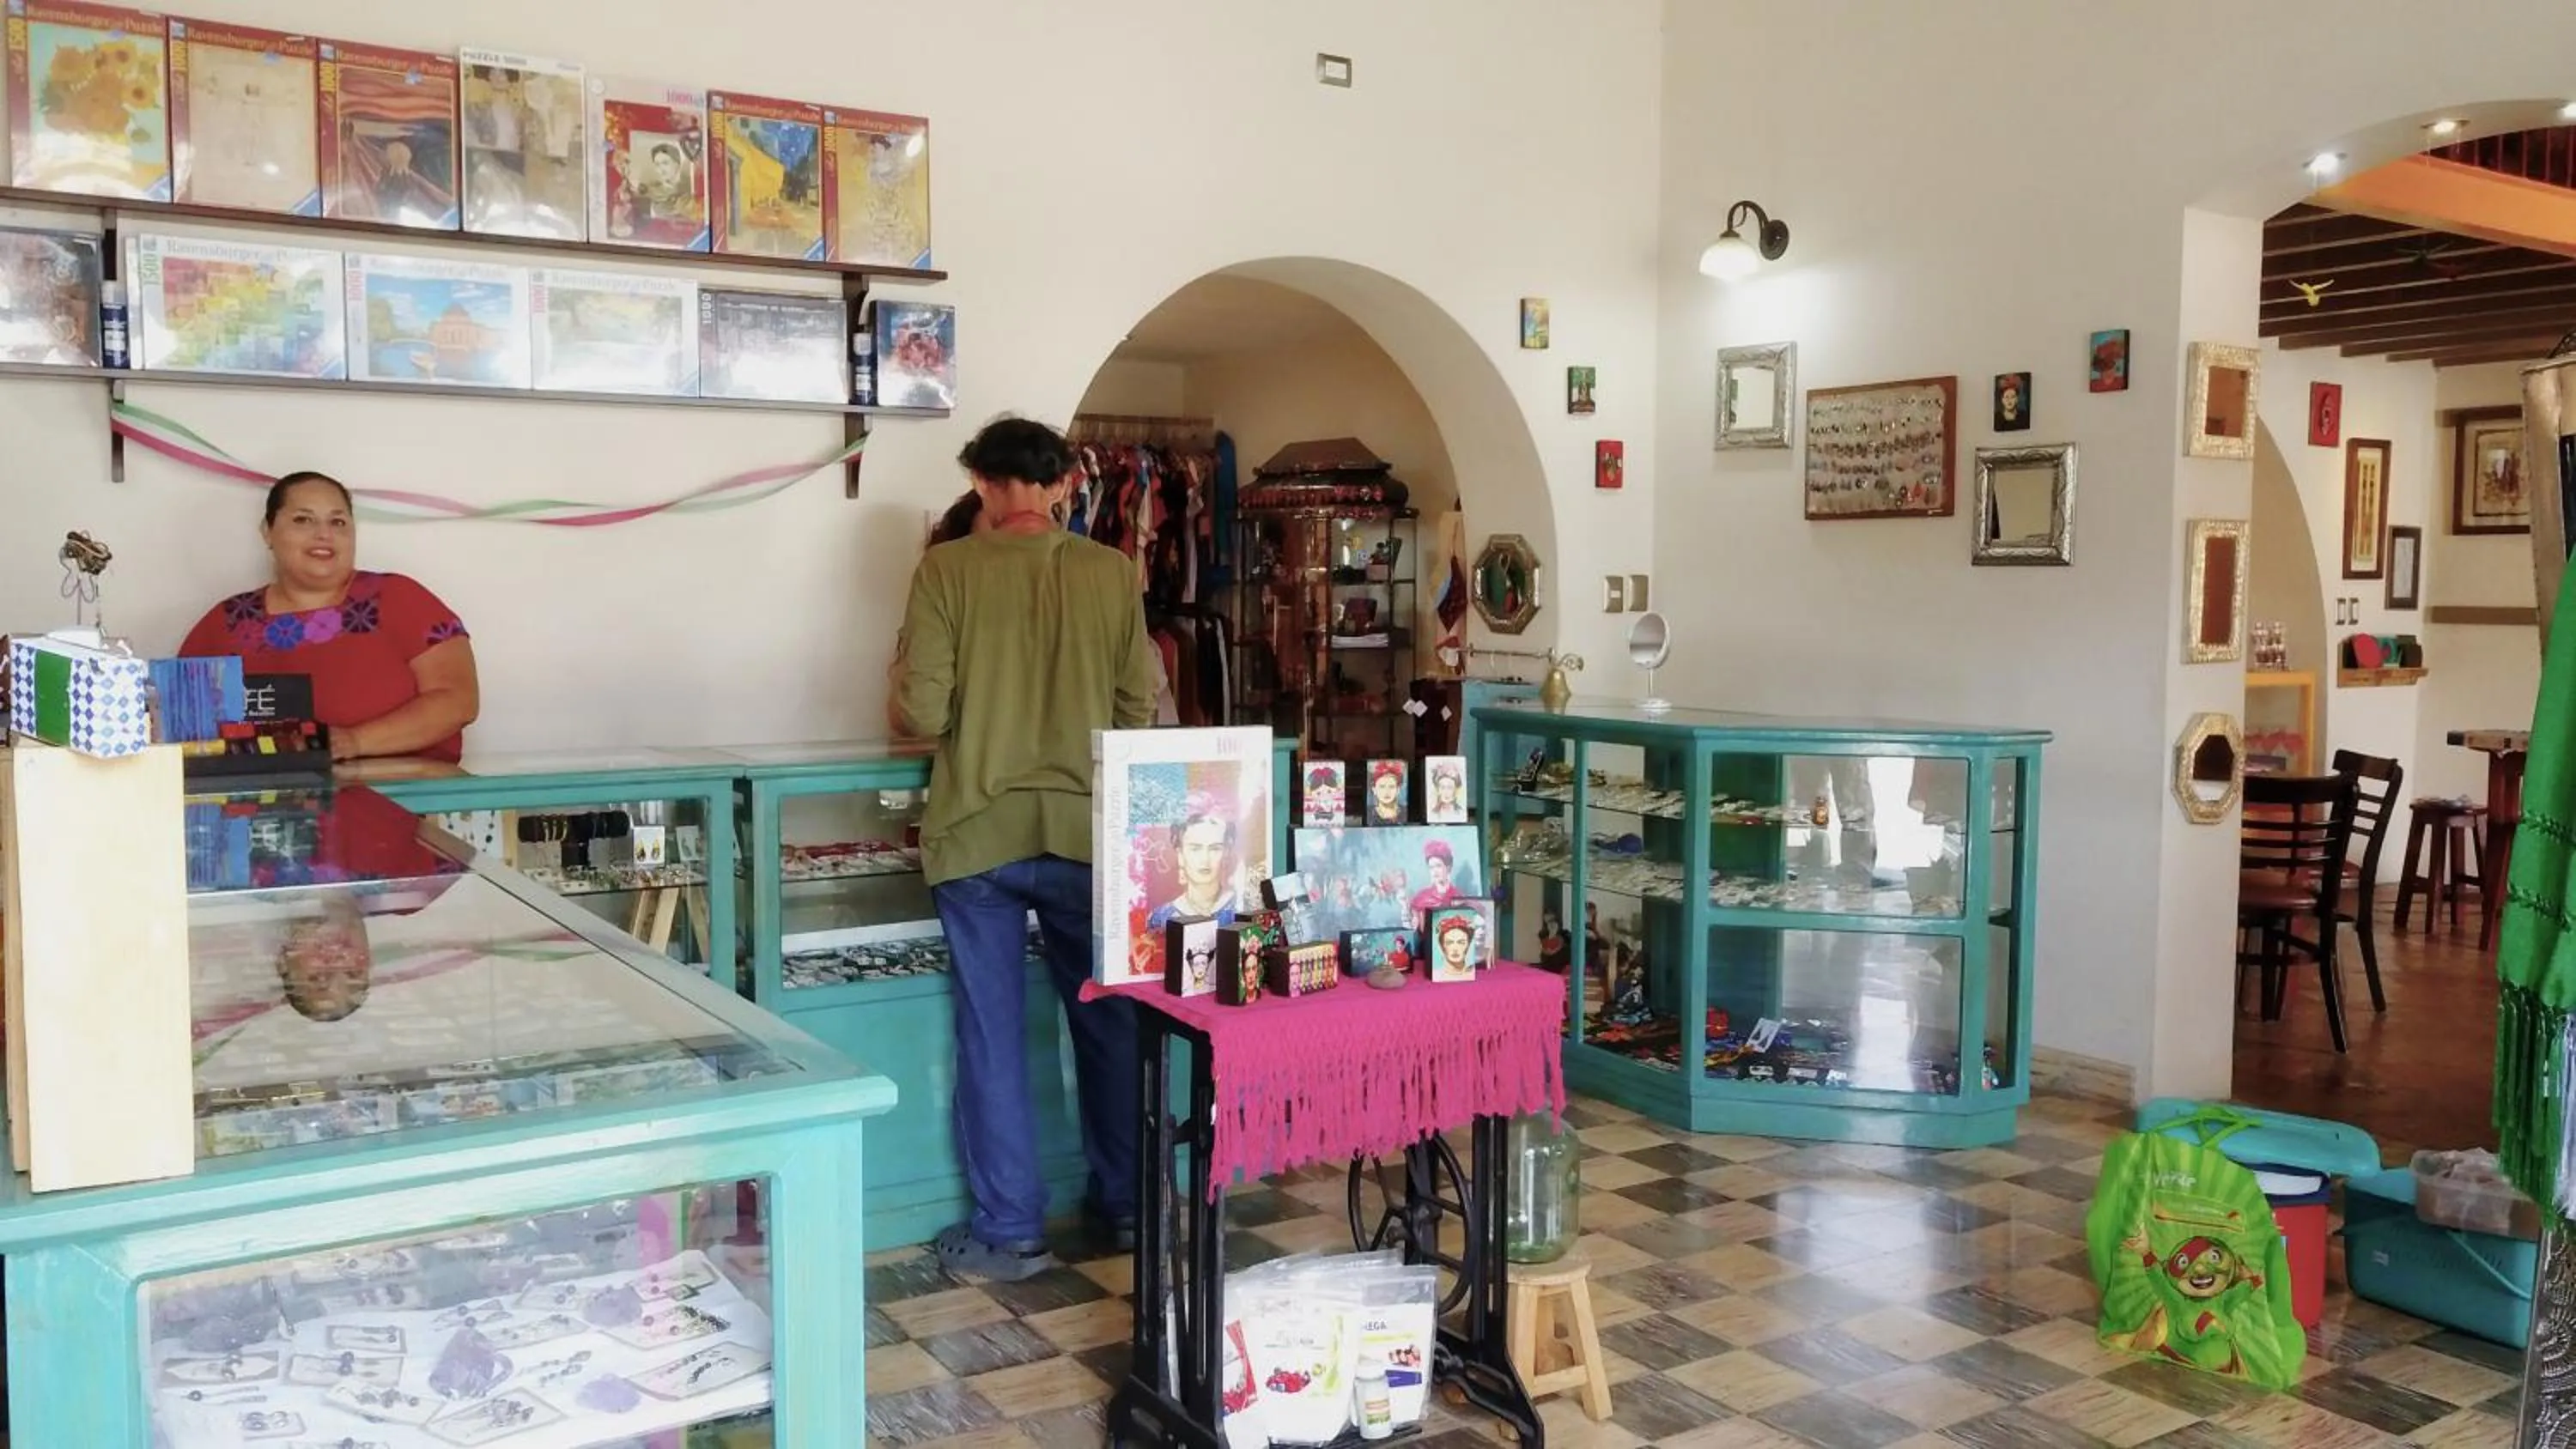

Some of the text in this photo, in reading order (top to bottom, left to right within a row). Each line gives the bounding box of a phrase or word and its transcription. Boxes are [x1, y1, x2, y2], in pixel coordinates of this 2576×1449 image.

[125, 19, 164, 33] Puzzle
[167, 239, 260, 262] Ravensburger
[142, 252, 159, 286] 1500
